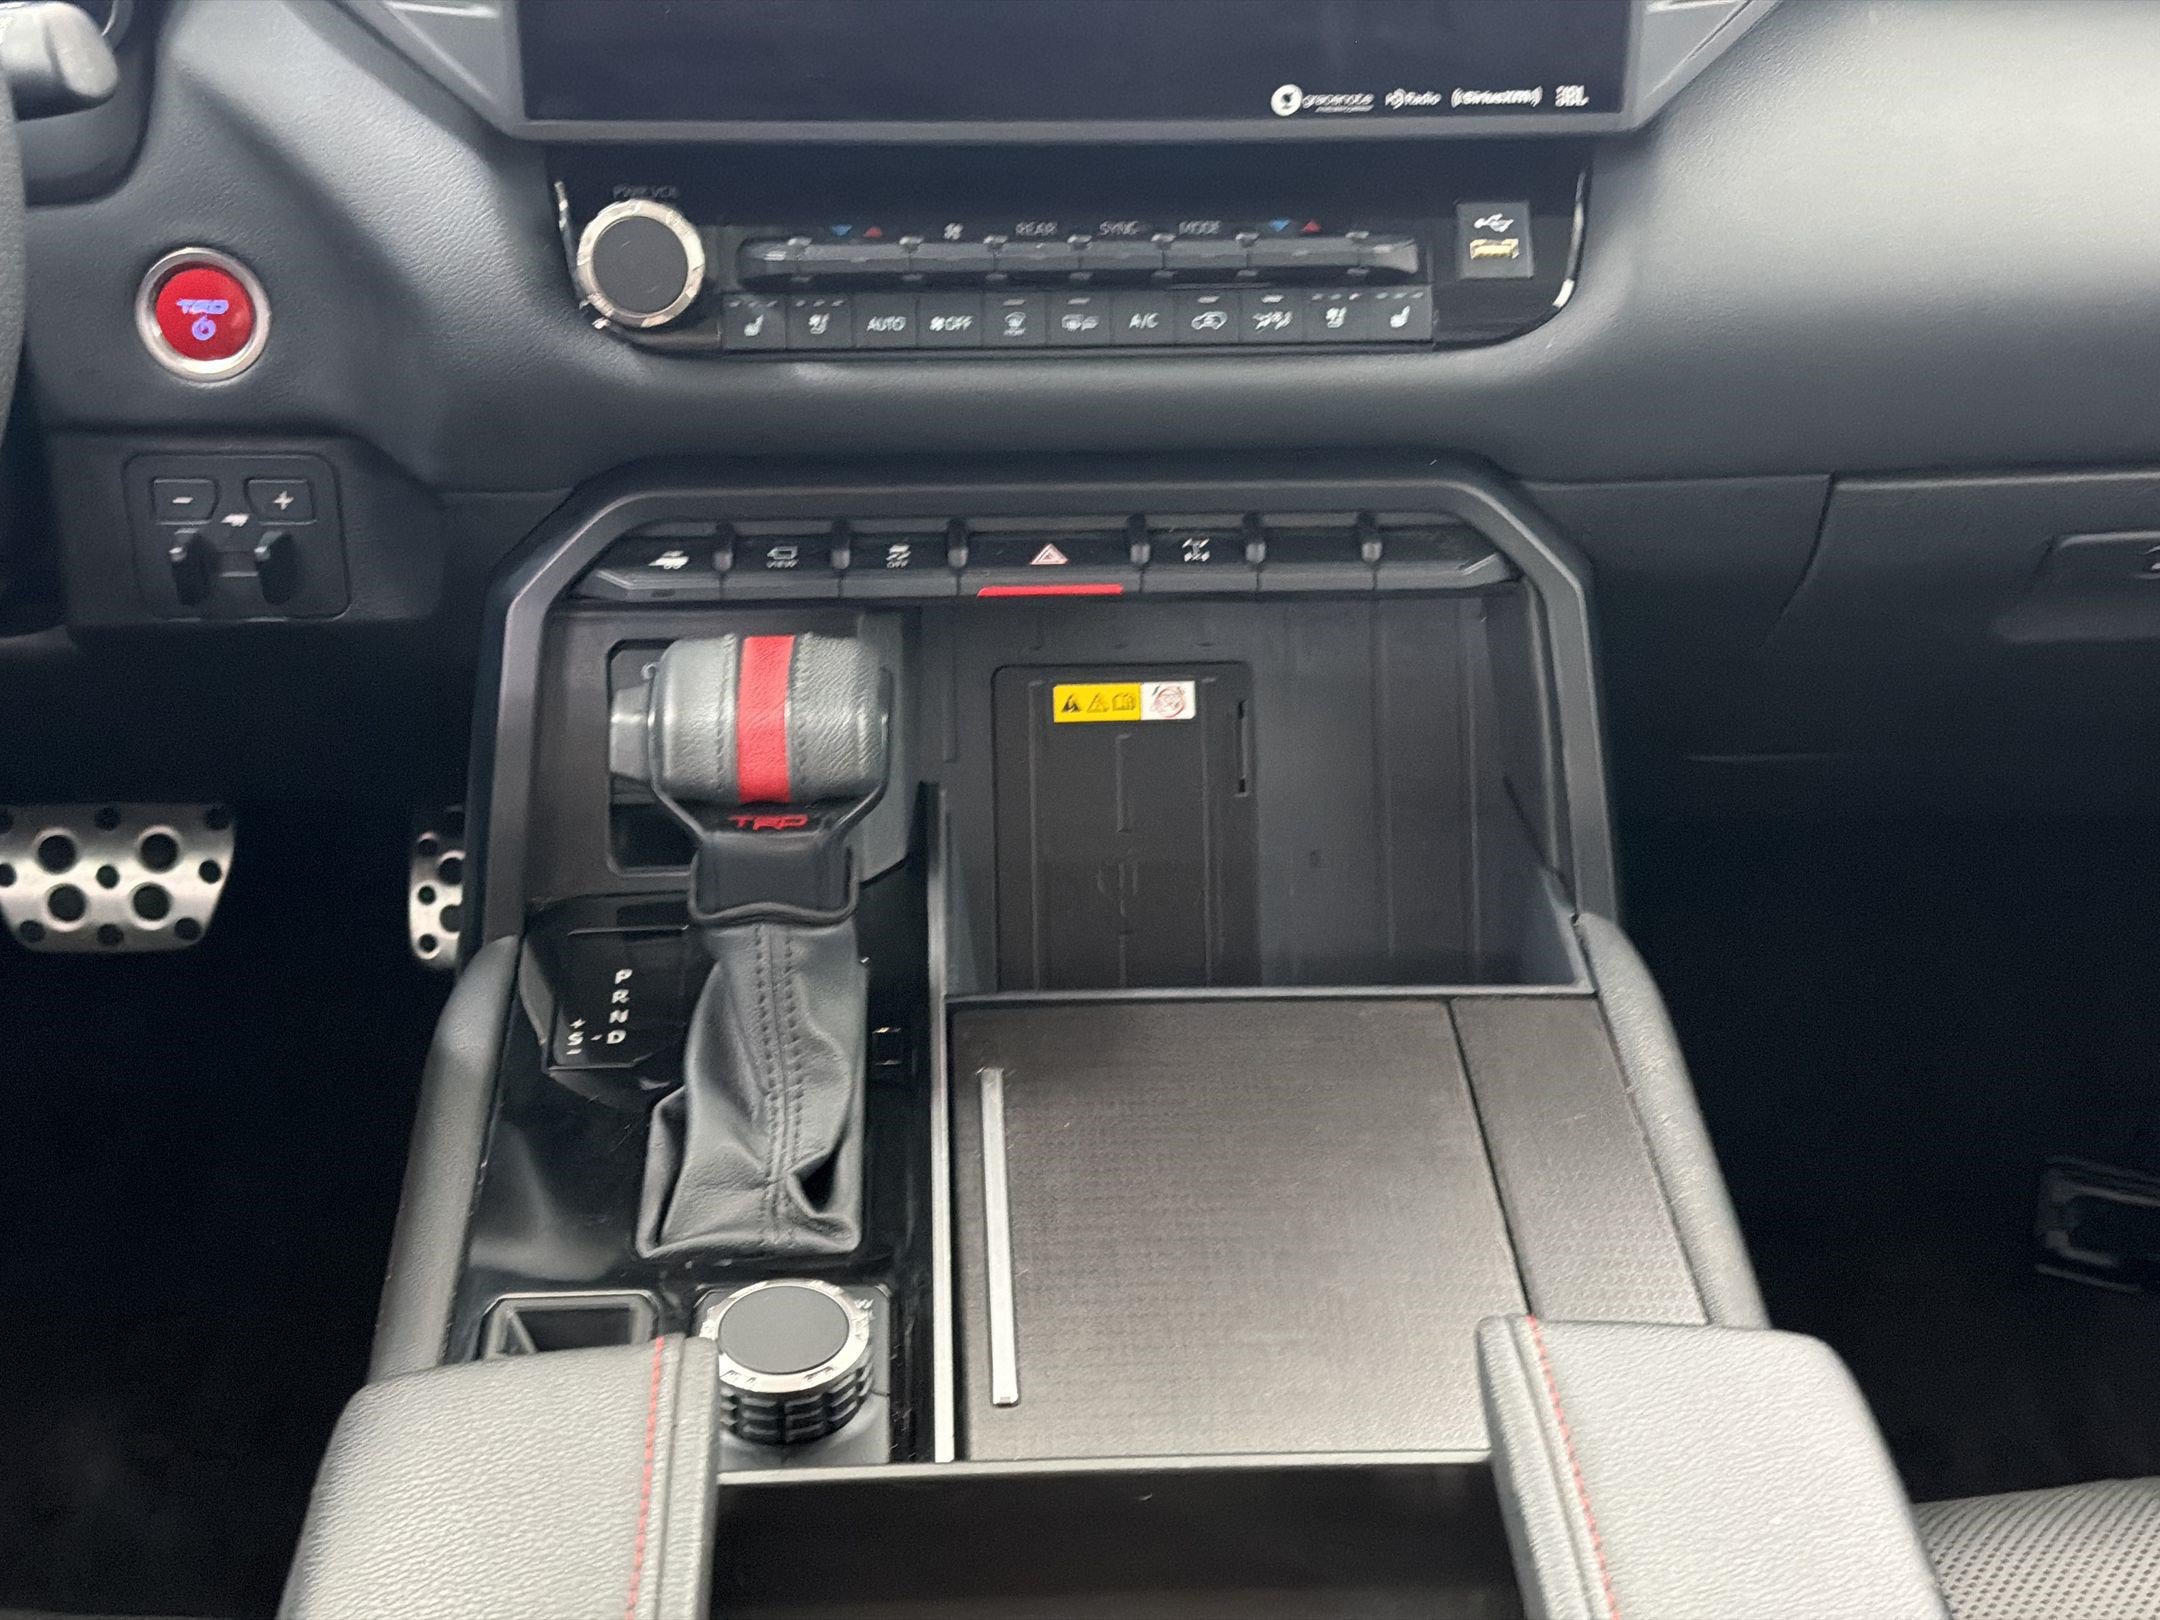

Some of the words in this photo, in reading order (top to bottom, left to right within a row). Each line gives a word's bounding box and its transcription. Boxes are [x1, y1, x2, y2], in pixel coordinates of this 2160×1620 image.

[866, 316, 906, 332] AUTO
[944, 315, 973, 331] OFF
[1129, 313, 1158, 330] A/C
[729, 813, 809, 832] TRD
[614, 968, 633, 983] P
[612, 991, 630, 1004] R
[609, 1010, 628, 1025] N
[606, 1030, 627, 1045] D
